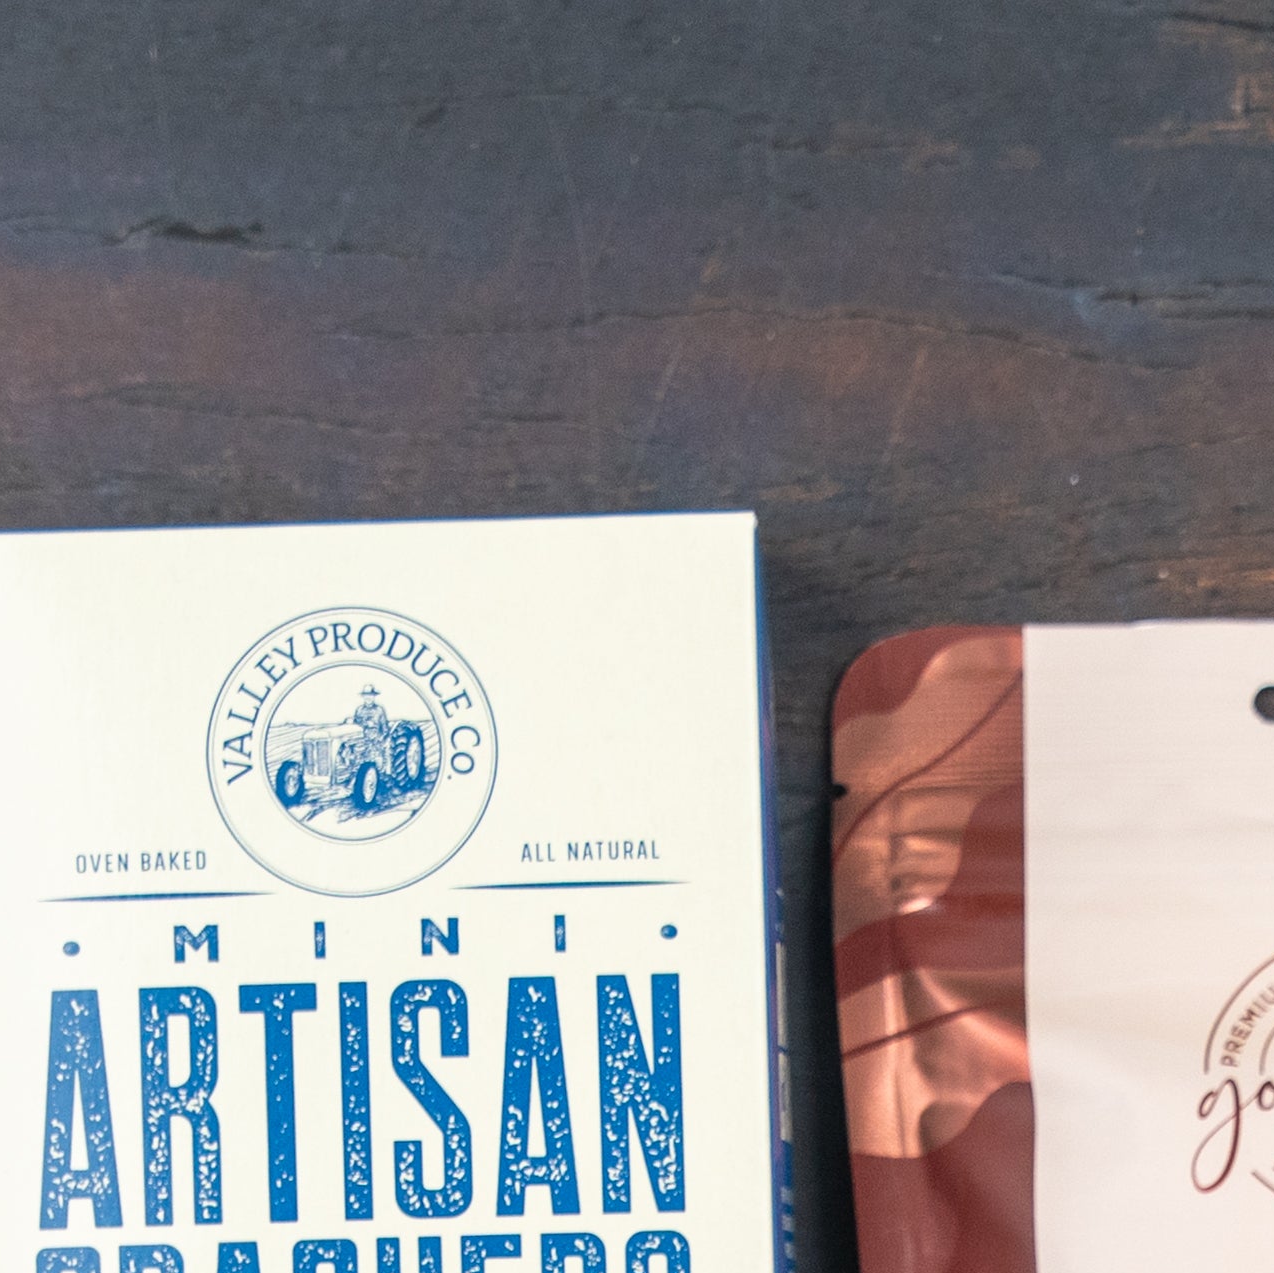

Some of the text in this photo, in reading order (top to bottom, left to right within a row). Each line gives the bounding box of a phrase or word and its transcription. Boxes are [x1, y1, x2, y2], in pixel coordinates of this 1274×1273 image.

[223, 636, 302, 786] VALLEY
[305, 622, 473, 718] PRODUCE
[75, 850, 207, 874] OVEN BAKED
[521, 839, 661, 864] ALL NATURAL
[39, 973, 686, 1230] ARTISAN
